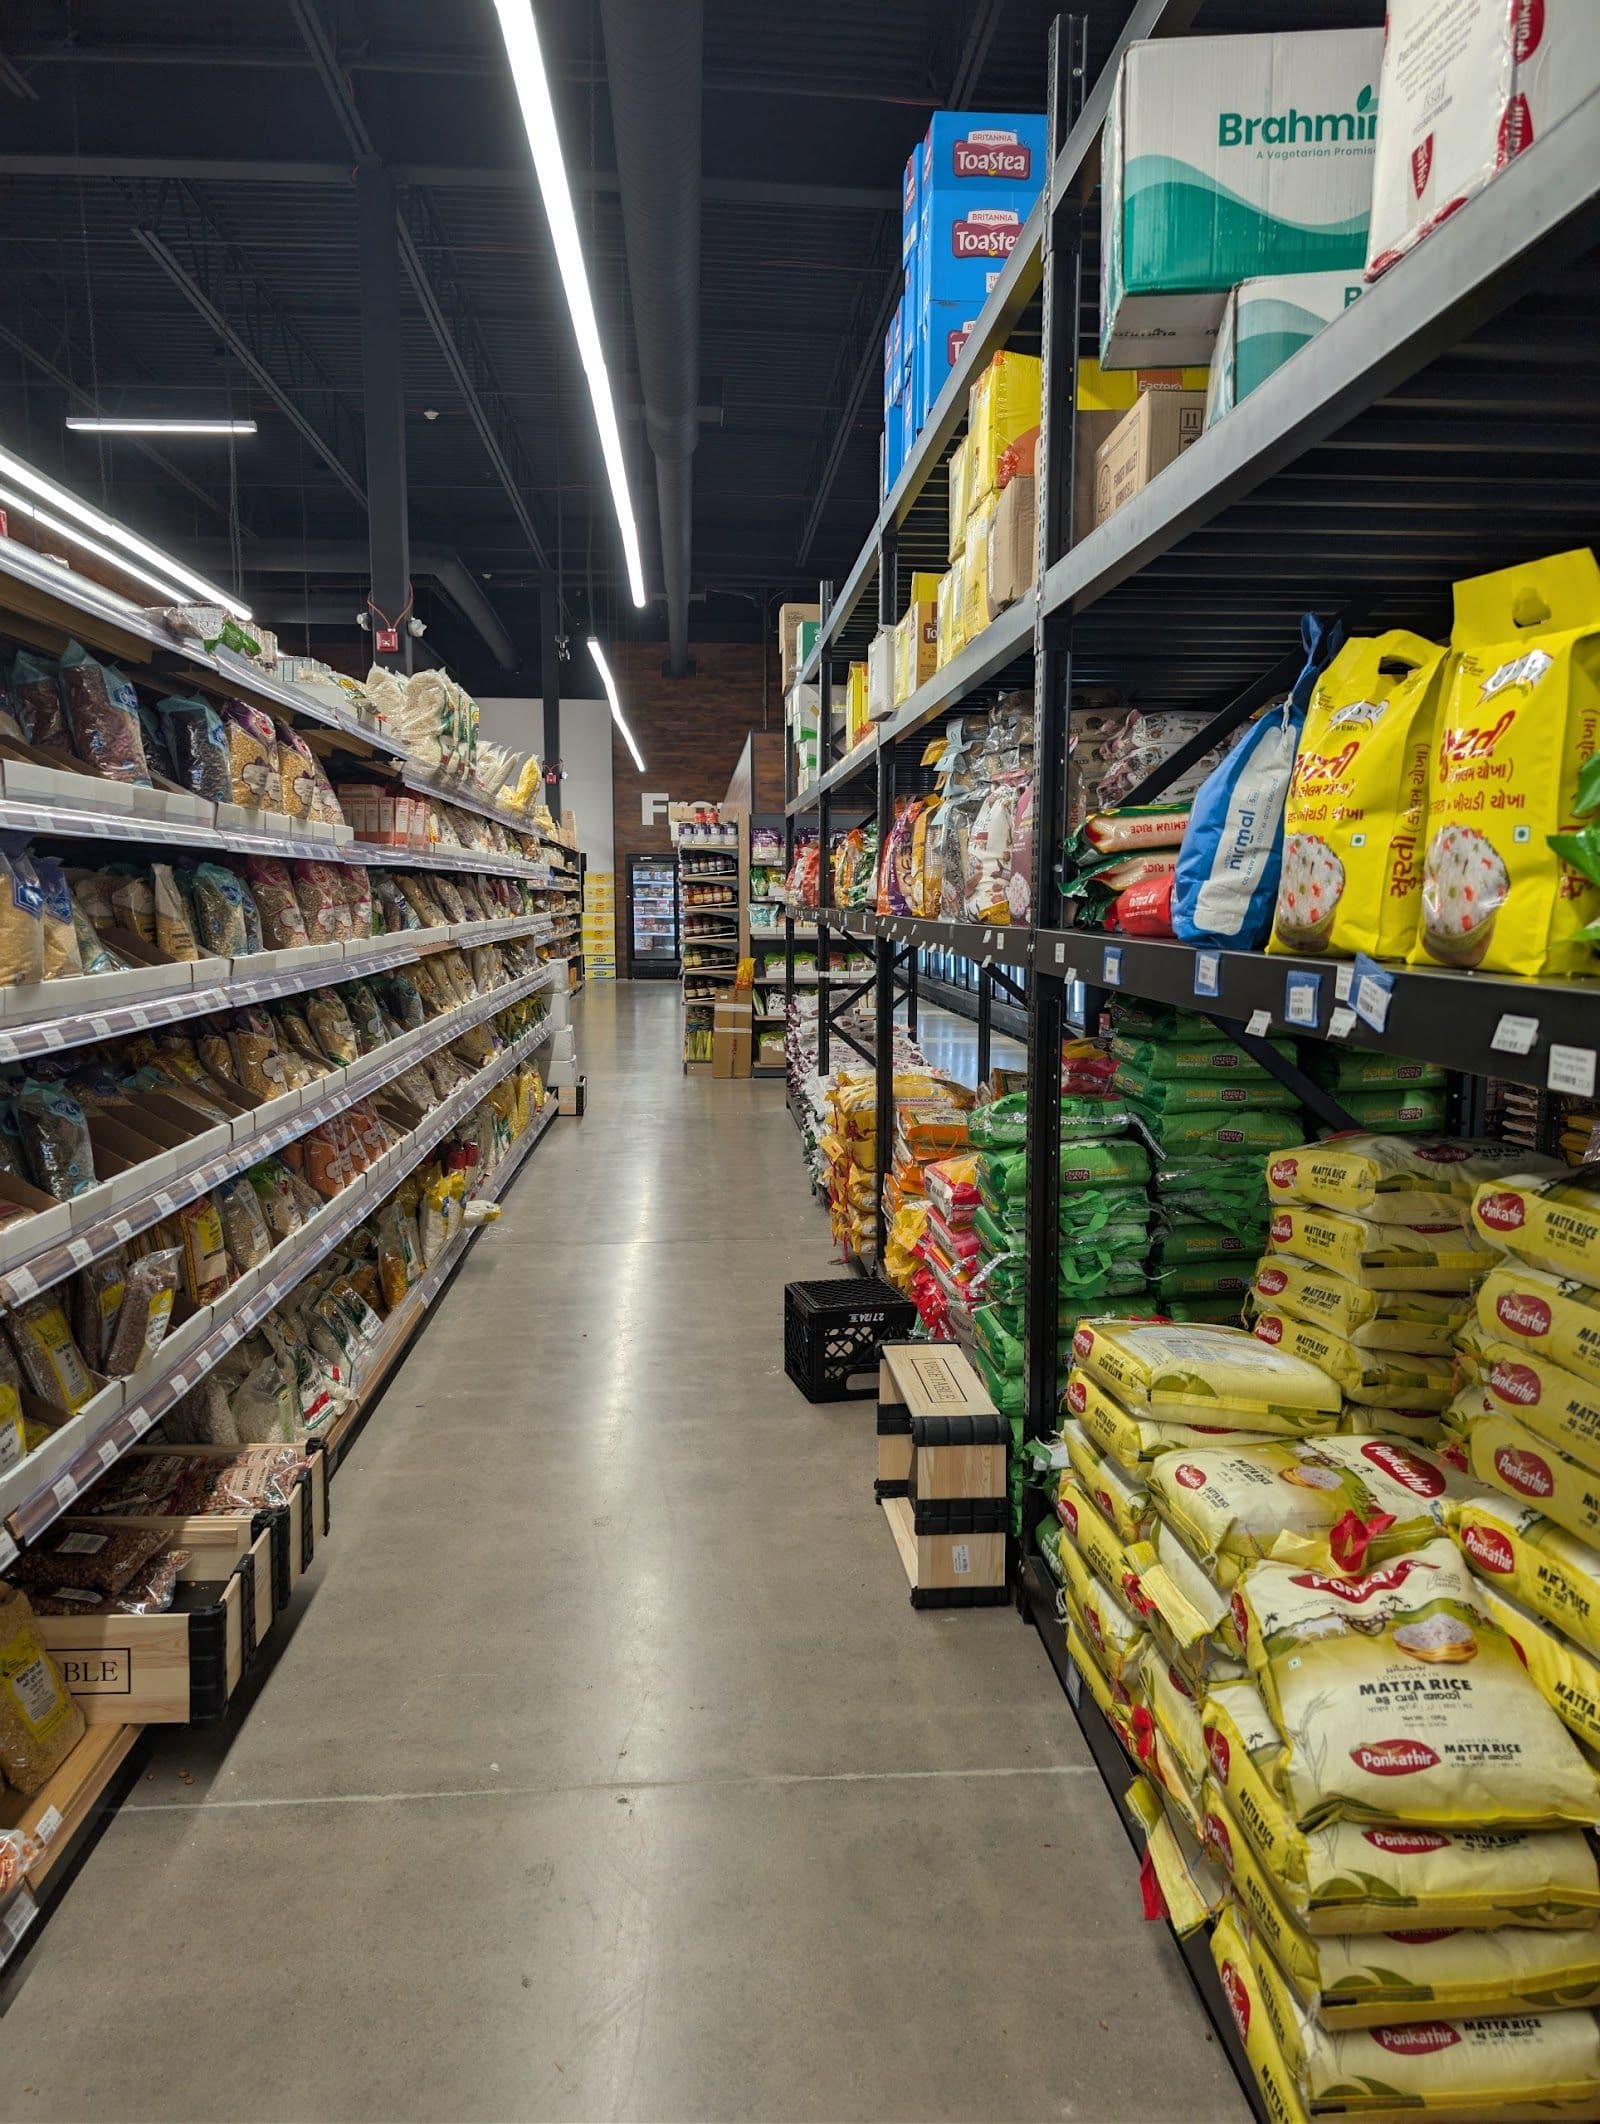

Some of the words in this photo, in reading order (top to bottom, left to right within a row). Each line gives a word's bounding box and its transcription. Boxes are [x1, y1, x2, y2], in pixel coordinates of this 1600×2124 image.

[972, 133, 1013, 142] BRITANNIA
[1256, 151, 1263, 159] A
[1267, 149, 1331, 160] Vegetarian
[972, 213, 1014, 222] BRITANNIA
[1130, 823, 1153, 834] RICE
[1229, 809, 1256, 870] nirmal
[1311, 1165, 1331, 1177] MATTA
[1331, 1168, 1347, 1180] RICE
[1303, 1224, 1322, 1238] MATTA
[1321, 1230, 1336, 1243] RICE
[1545, 1212, 1576, 1232] MATTA
[1575, 1222, 1599, 1240] RICE
[1302, 1286, 1326, 1300] MATTA
[1326, 1293, 1341, 1305] RICE
[1499, 1299, 1549, 1334] Ponkathir
[1296, 1334, 1316, 1349] MATTA
[1315, 1342, 1329, 1356] RICE
[1367, 1446, 1433, 1495] Ponkathir
[1499, 1454, 1550, 1495] Ponkathir
[1466, 1531, 1513, 1572] Ponkathir
[1359, 1680, 1426, 1696] MATTA
[1431, 1679, 1473, 1691] RICE
[1554, 1681, 1597, 1717] MATTA
[1362, 1749, 1433, 1768] Ponkathir
[1444, 1744, 1488, 1753] MATTA
[1490, 1744, 1522, 1753] RICE
[1239, 1789, 1260, 1828] MATTA
[1257, 1820, 1274, 1850] RICE
[1383, 2028, 1451, 2046] Ponkathir
[1464, 2020, 1508, 2031] MATTA
[1511, 2019, 1542, 2029] RICE
[1261, 2064, 1285, 2121] MATTA
